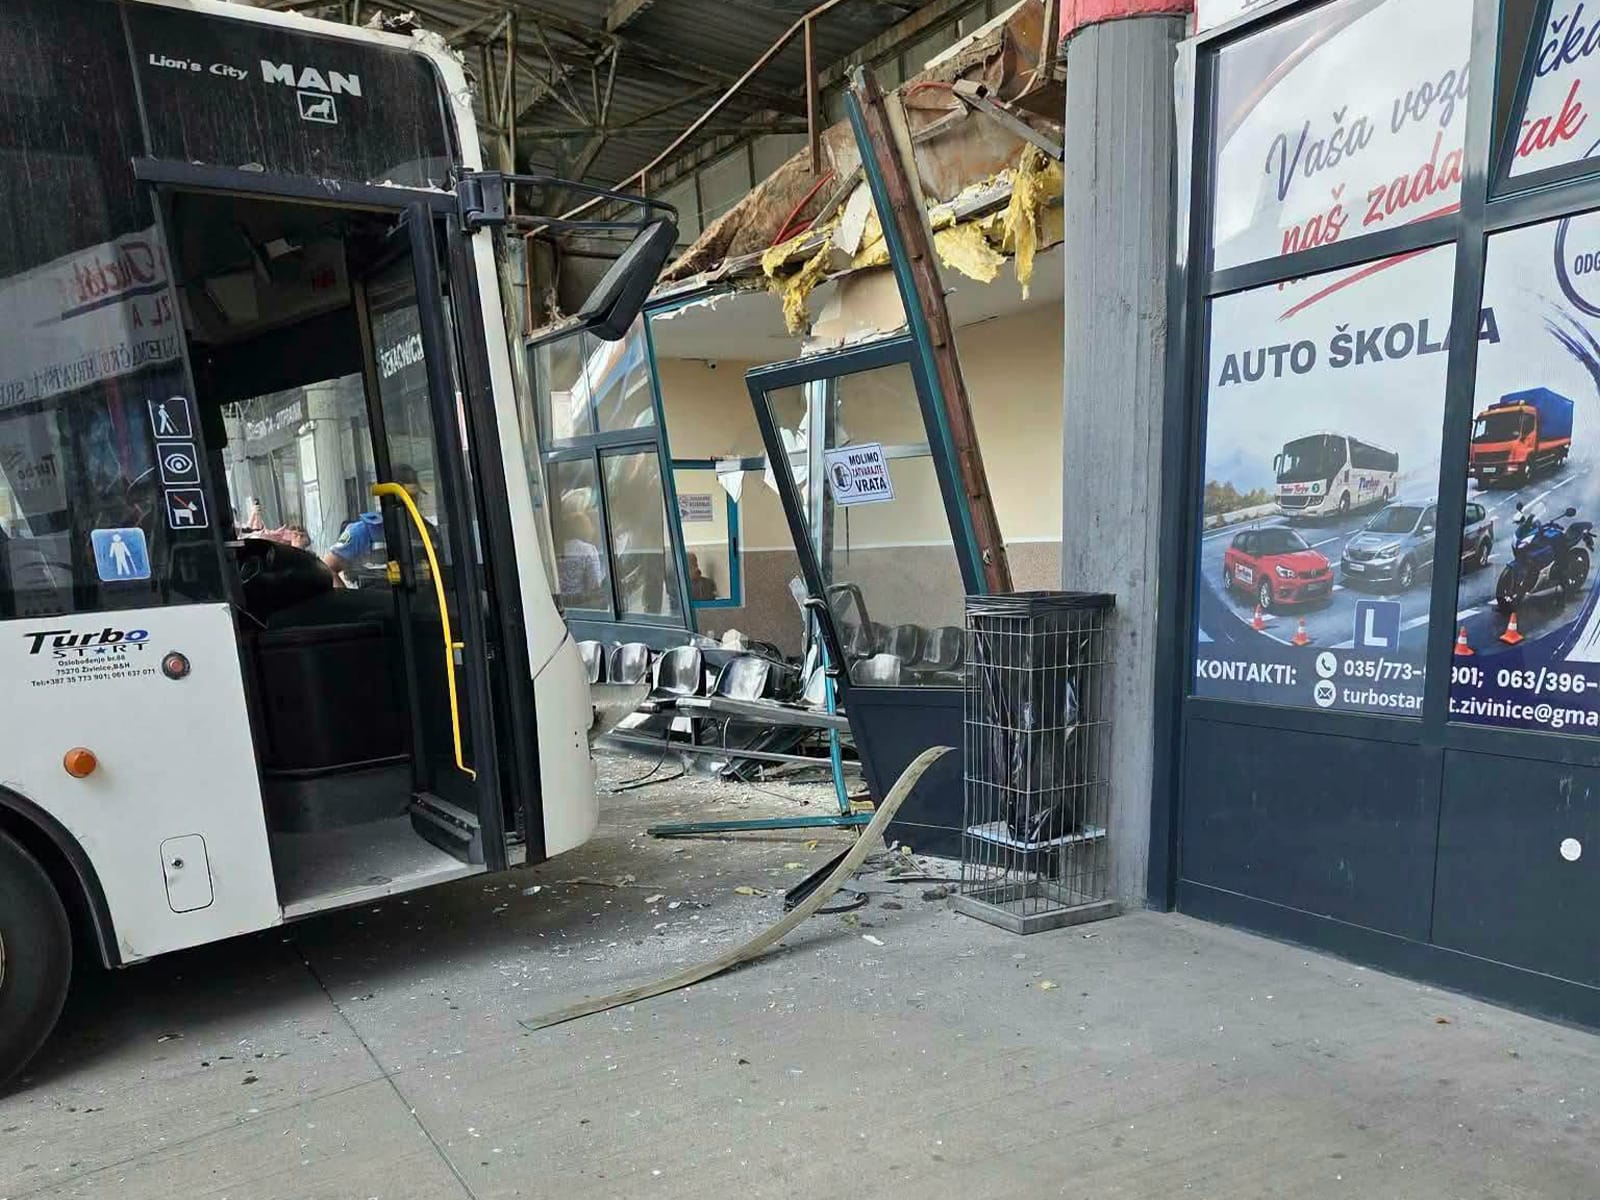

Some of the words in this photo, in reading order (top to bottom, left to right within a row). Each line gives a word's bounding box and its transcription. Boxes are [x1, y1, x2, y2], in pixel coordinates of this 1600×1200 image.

[149, 53, 202, 72] Lion's
[208, 63, 249, 81] City
[260, 59, 362, 97] MAN
[1265, 105, 1374, 202] Vaša
[1280, 183, 1349, 257] naš
[1218, 339, 1317, 387] AUTO
[849, 451, 879, 466] MOLIMO
[855, 476, 888, 493] VRATA
[23, 627, 149, 655] Turbo
[1364, 608, 1388, 647] L
[1196, 659, 1297, 686] KONTAKTI:
